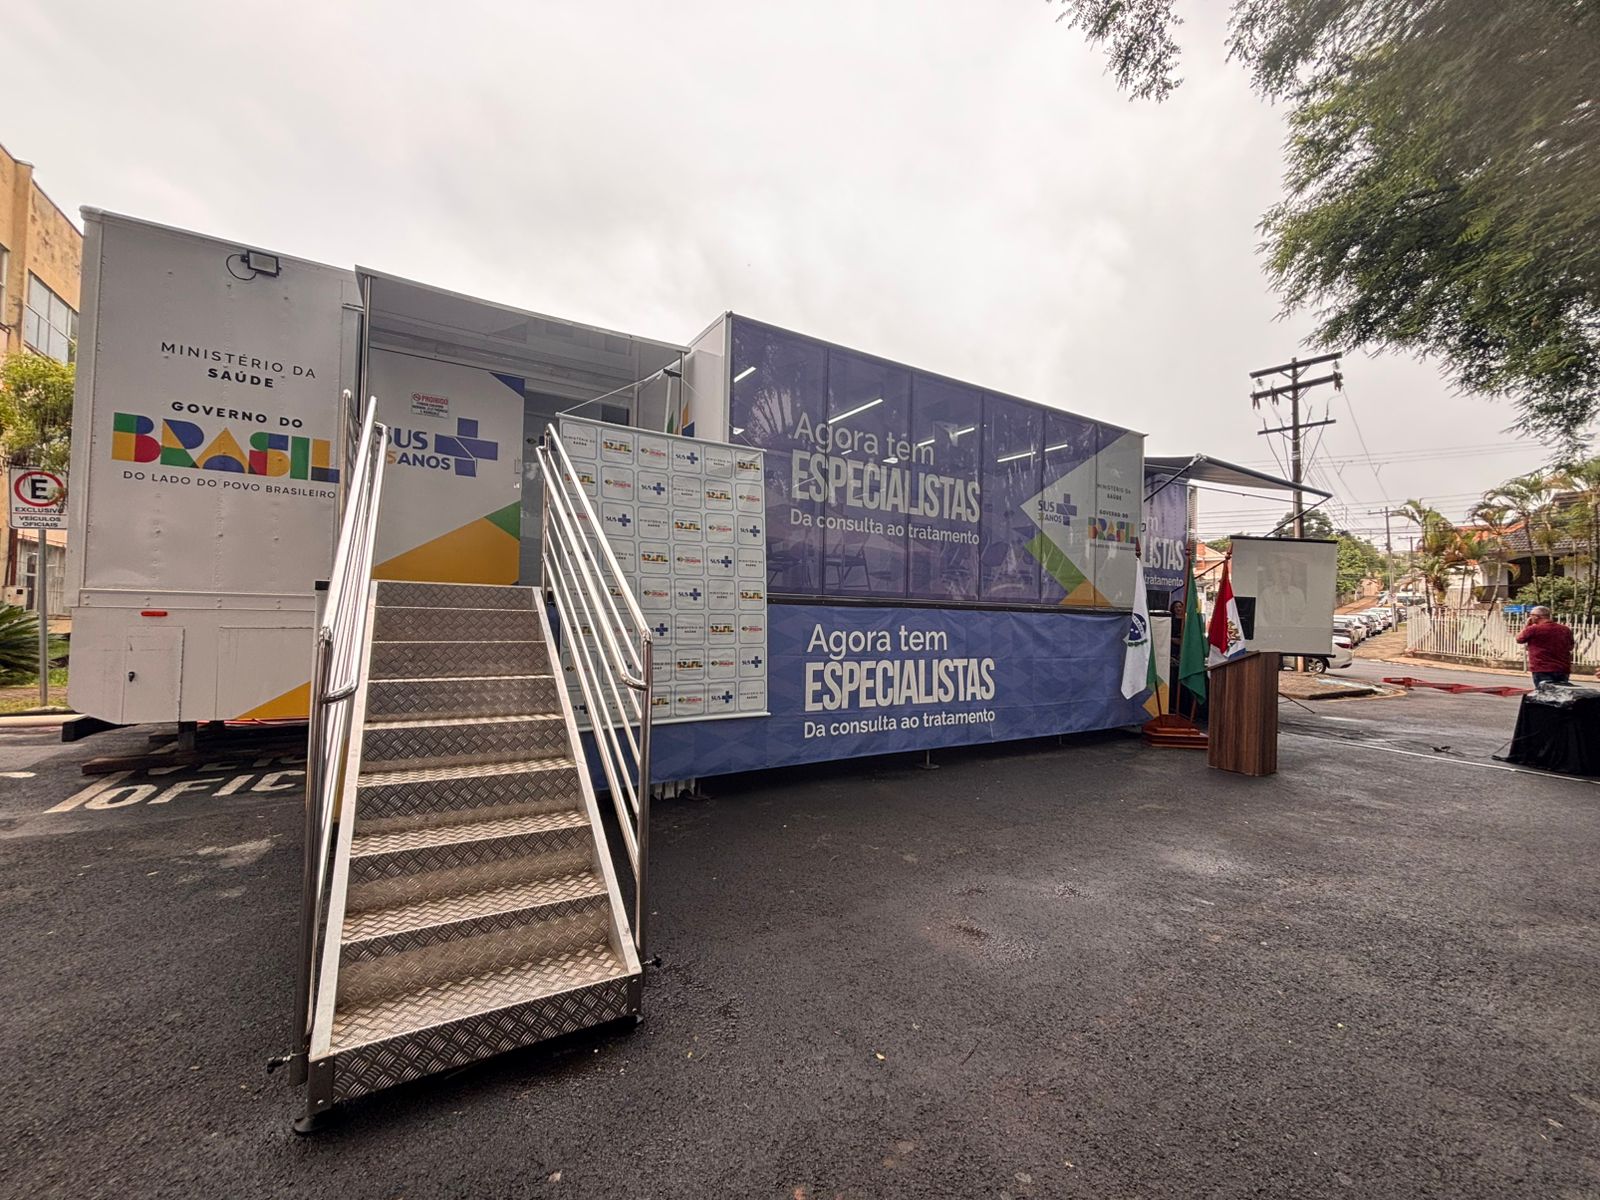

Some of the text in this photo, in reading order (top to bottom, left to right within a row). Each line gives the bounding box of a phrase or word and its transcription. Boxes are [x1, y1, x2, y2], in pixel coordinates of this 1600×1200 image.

[161, 341, 316, 379] MINISTÉRIO DA
[208, 368, 274, 388] SAÚDE
[171, 401, 303, 428] GOVERNO DO
[111, 411, 340, 483] BRASIL
[793, 411, 879, 453] Agora
[397, 452, 451, 470] ANOS
[31, 478, 49, 499] E
[123, 470, 336, 499] DO LADO DO POVO BRASILEIRO
[791, 449, 980, 523] ESPECIALISTAS
[1038, 500, 1055, 512] SUS
[790, 508, 980, 545] Da consulta ao tratamento
[1088, 516, 1137, 544] BRASIL
[806, 623, 948, 660] Agora tem
[804, 658, 996, 712] ESPECIALISTAS
[804, 708, 996, 739] Da consulta ao tratamento
